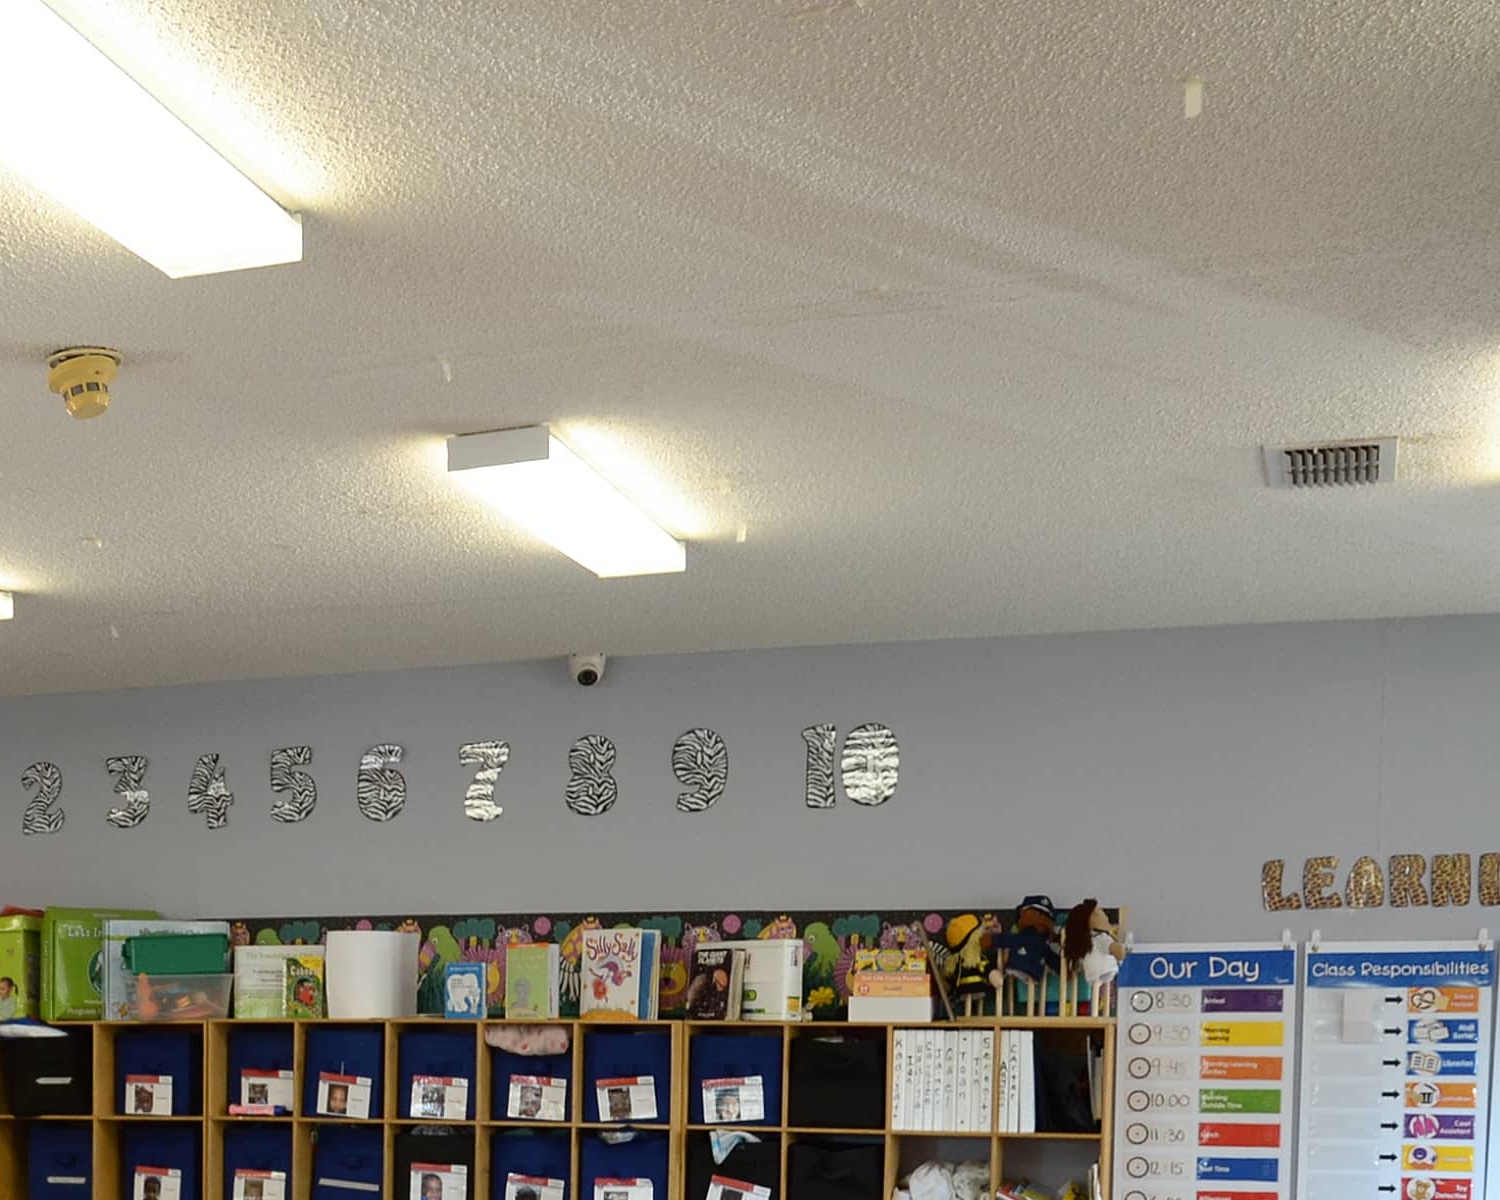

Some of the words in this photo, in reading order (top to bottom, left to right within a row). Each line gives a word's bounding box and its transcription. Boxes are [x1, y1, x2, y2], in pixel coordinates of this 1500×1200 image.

[21, 760, 66, 835] 2
[105, 755, 149, 828] 3
[187, 752, 234, 829] 4
[269, 746, 318, 824] 5
[356, 743, 407, 823] 6
[459, 740, 511, 822] 7
[564, 734, 618, 816] 8
[671, 727, 729, 812] 9
[1150, 957, 1198, 979] Our
[1208, 957, 1260, 984] Day
[1312, 961, 1356, 978] Class
[1361, 959, 1489, 979] Responsibilities
